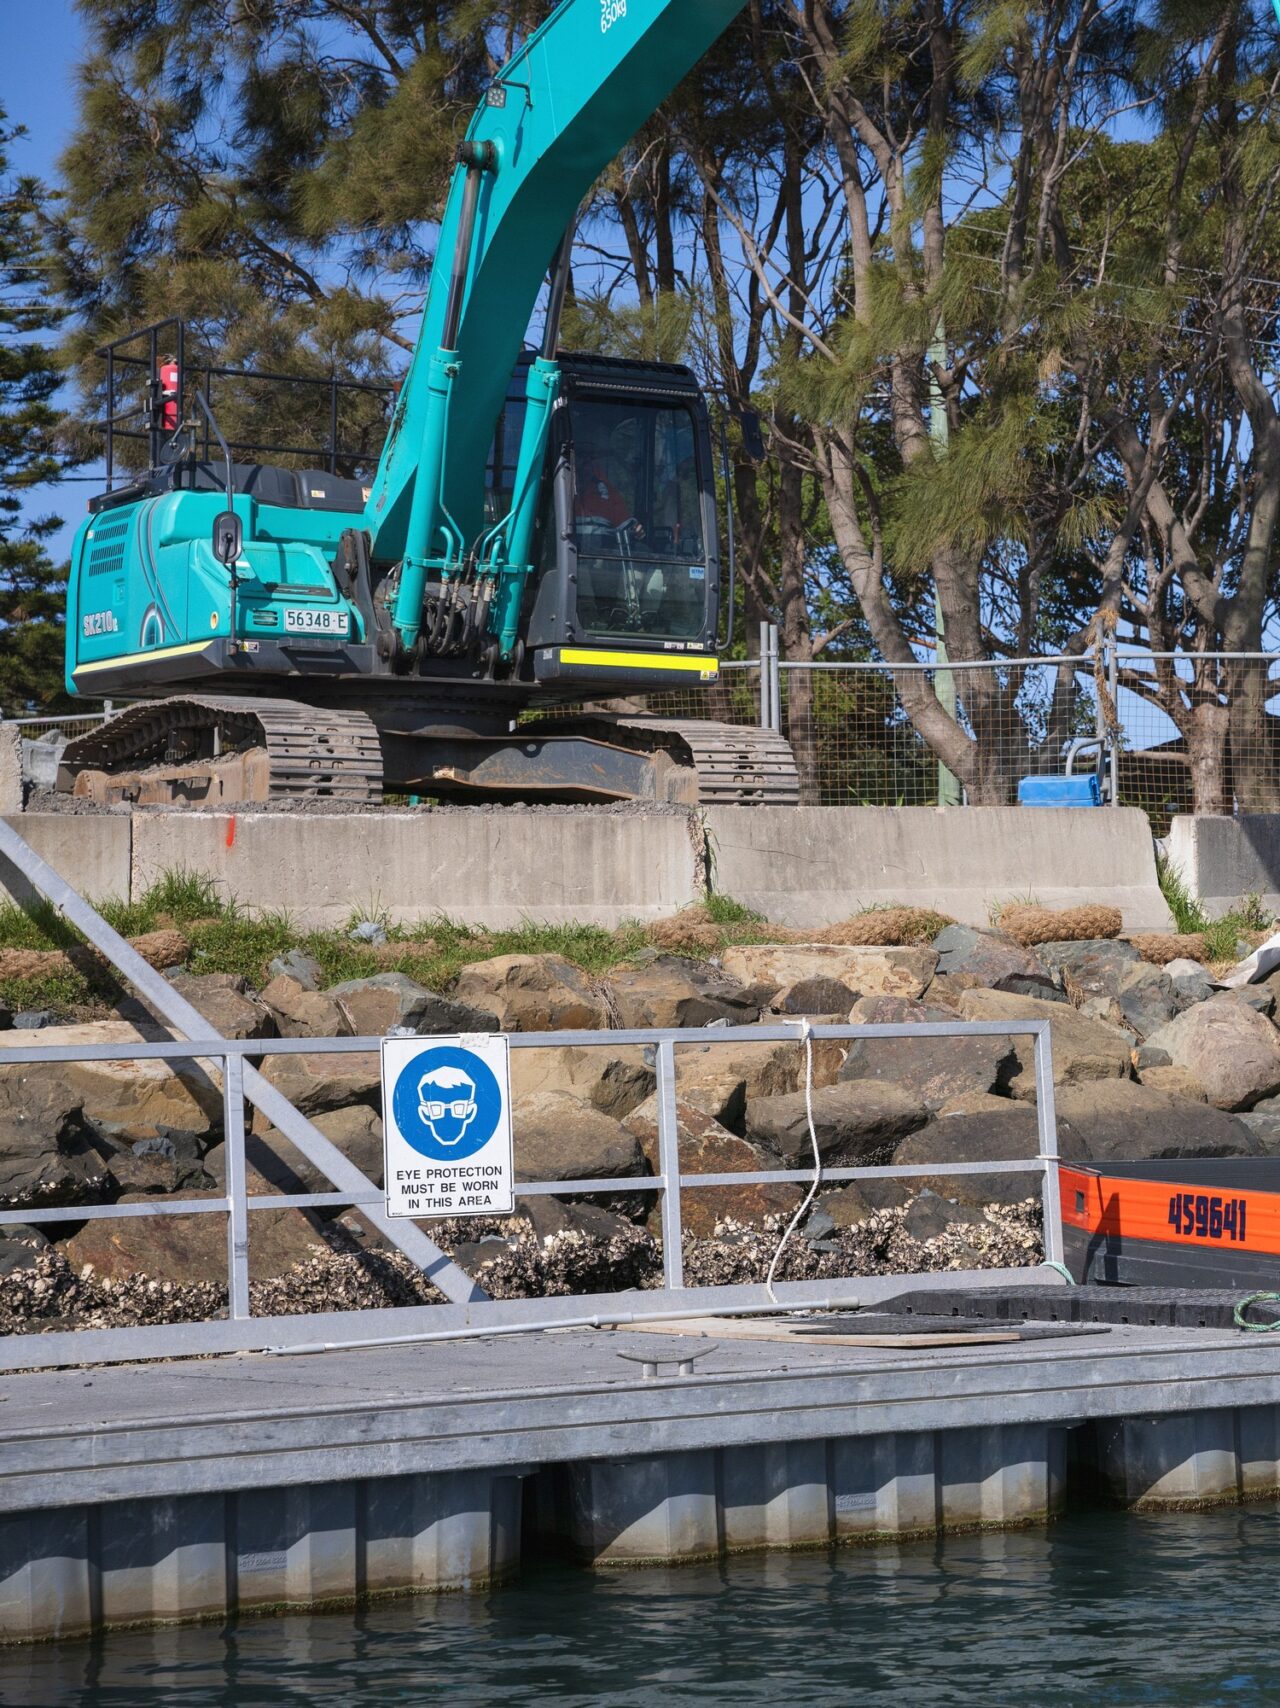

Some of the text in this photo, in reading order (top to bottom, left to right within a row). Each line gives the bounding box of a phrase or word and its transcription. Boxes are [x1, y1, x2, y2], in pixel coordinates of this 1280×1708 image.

[396, 1166, 502, 1180] EYE PROTECTION
[401, 1180, 498, 1195] MUST BE WORN
[408, 1195, 492, 1209] IN THIS AREA
[1168, 1193, 1246, 1241] 459641
